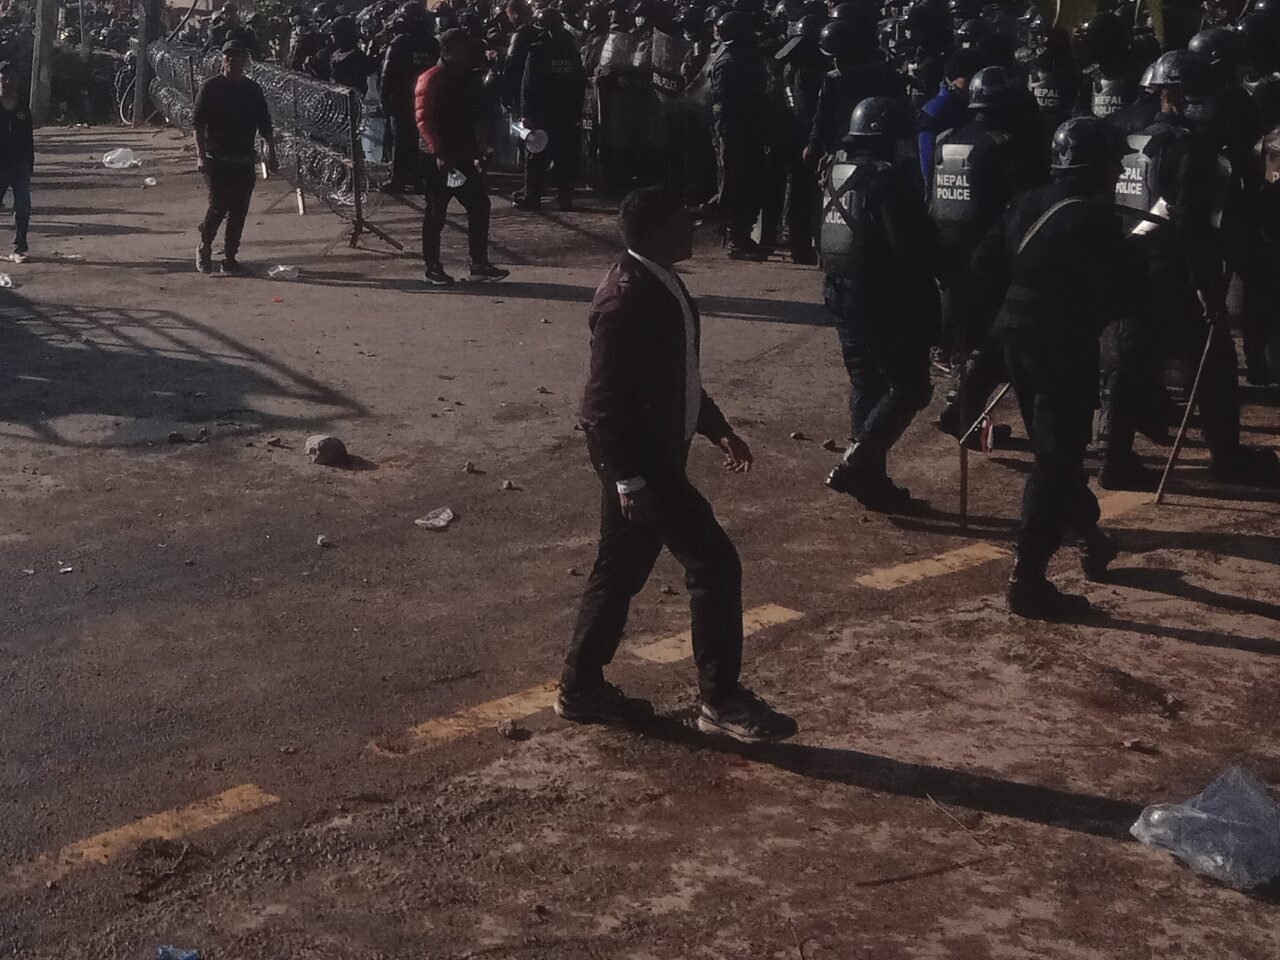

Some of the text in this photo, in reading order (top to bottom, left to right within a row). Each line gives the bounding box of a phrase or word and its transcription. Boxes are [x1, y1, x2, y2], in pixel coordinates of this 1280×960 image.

[936, 174, 970, 187] NEPAL
[936, 188, 971, 201] POLICE
[1115, 181, 1142, 195] POLICE
